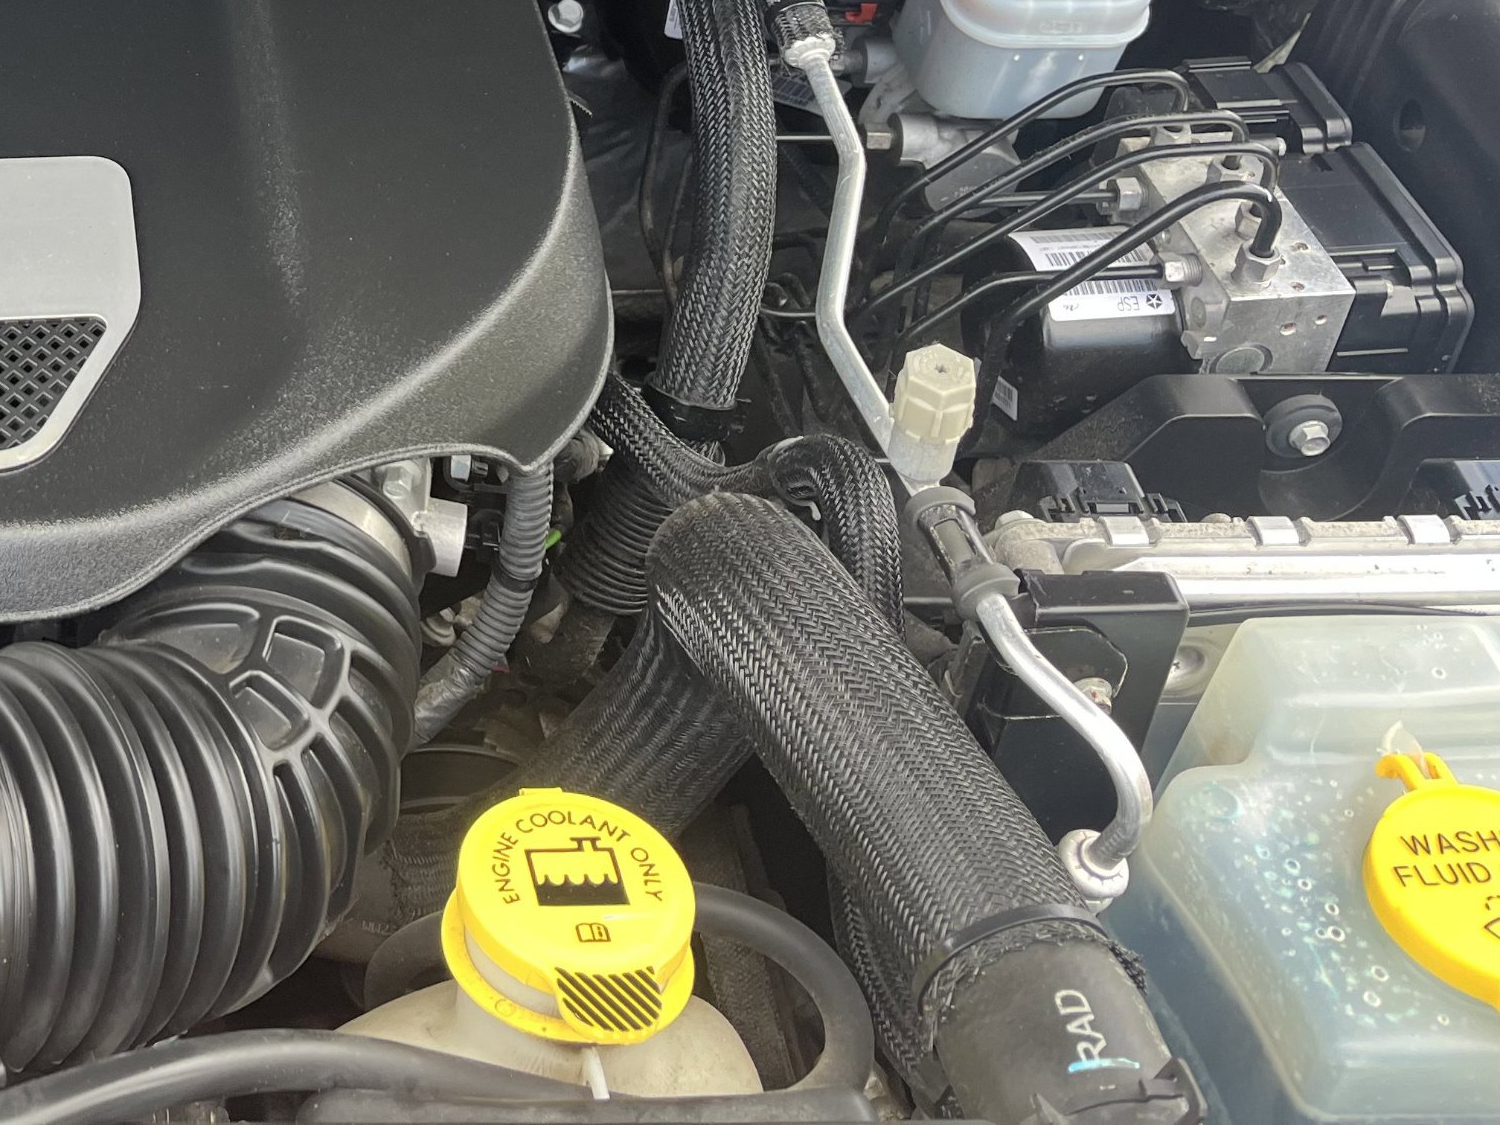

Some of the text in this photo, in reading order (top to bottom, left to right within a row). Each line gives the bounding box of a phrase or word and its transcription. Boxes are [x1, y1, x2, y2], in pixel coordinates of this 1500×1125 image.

[1117, 295, 1140, 312] ESP
[1400, 830, 1500, 856] WASH
[491, 810, 663, 905] ENGINE COOLANT ONLY
[1393, 862, 1492, 888] FLUID
[1055, 989, 1107, 1062] RAD
